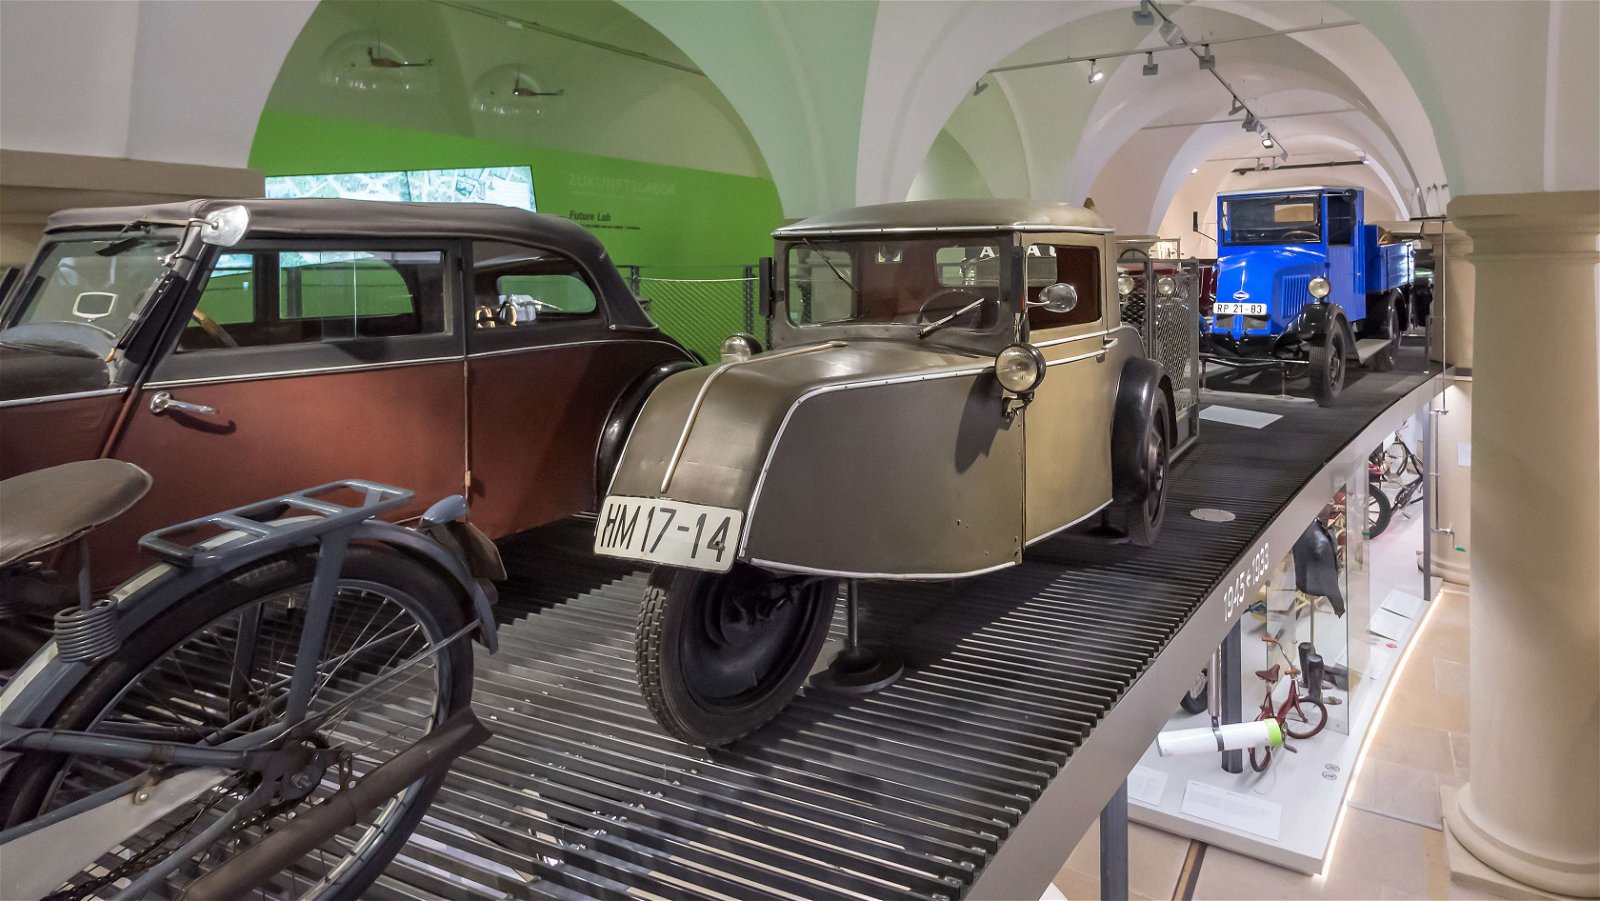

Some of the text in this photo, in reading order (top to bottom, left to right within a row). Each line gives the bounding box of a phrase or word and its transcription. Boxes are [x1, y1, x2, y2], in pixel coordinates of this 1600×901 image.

[569, 210, 611, 222] Future Lab
[1217, 304, 1229, 313] RP
[600, 504, 731, 562] HM 17-14
[1224, 571, 1245, 621] 1945
